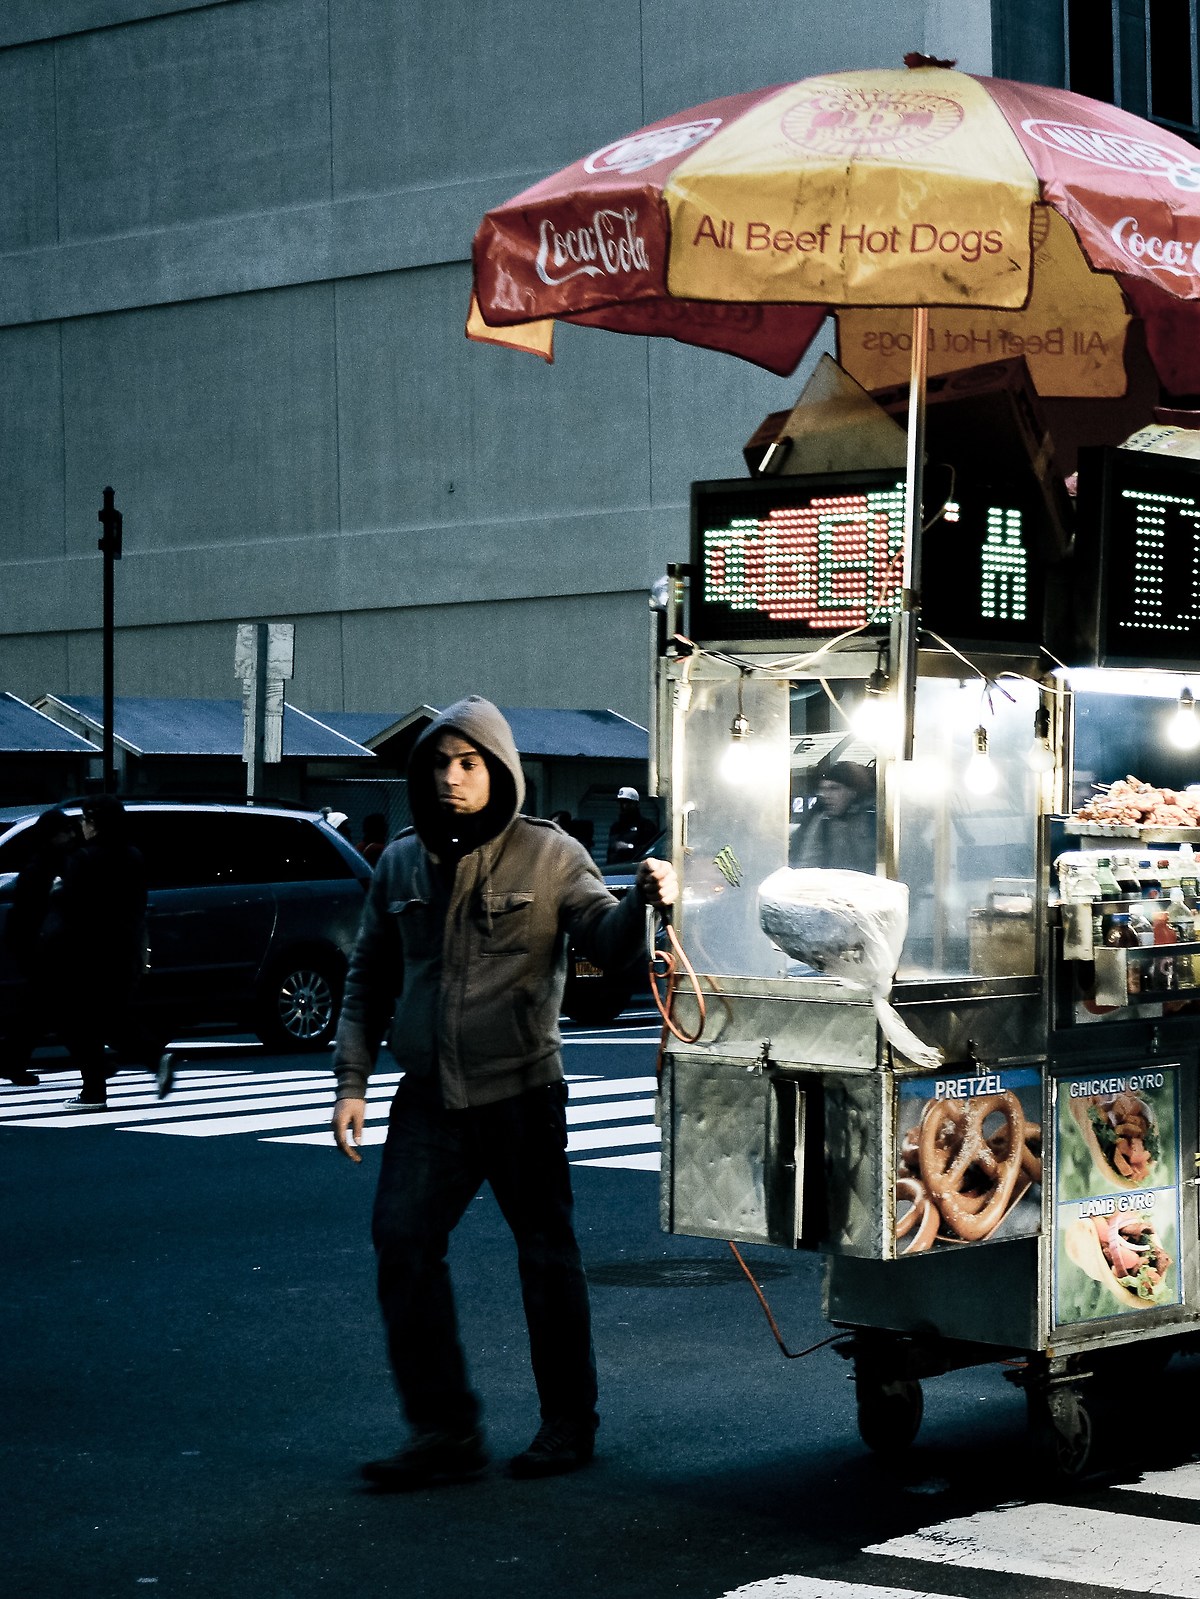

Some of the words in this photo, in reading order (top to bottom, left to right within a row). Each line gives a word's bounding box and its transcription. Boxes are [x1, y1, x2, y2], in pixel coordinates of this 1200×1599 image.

[536, 206, 650, 286] Coca-Cola
[693, 215, 733, 249] All
[747, 222, 830, 253] Beef
[839, 224, 900, 254] Hot
[910, 223, 1003, 263] Dogs
[935, 1076, 1006, 1100] PRETZEL
[1069, 1078, 1127, 1098] CHICKEN
[1129, 1073, 1165, 1092] GYRO
[1078, 1196, 1115, 1219] LAMB
[1117, 1190, 1156, 1212] GYRO
